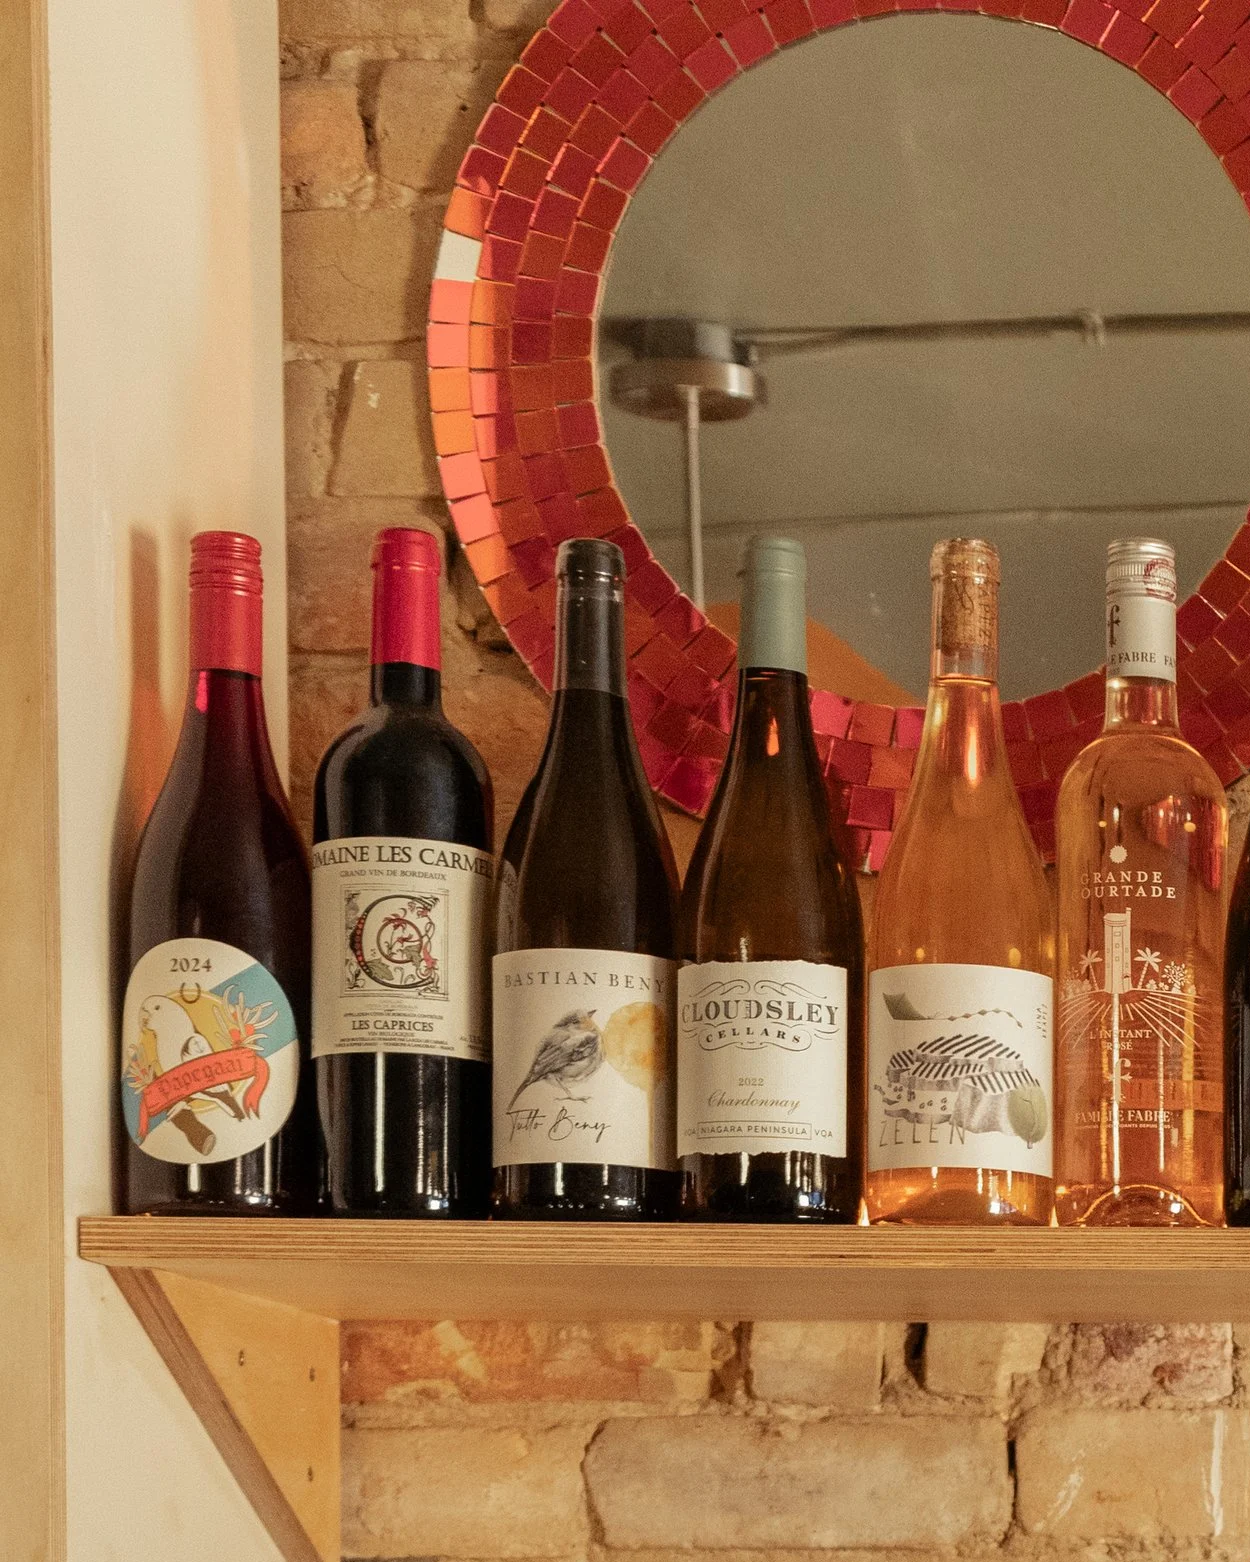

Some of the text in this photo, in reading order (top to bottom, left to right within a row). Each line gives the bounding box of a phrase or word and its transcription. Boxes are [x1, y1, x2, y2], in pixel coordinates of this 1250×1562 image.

[1118, 652, 1157, 664] FABRE
[313, 846, 369, 869] MAINE
[376, 845, 412, 863] LES
[400, 870, 448, 881] BORDEAUX
[1081, 871, 1163, 885] GRANDE
[170, 958, 212, 972] 2024
[504, 971, 665, 993] BASTIAN BENY
[682, 1000, 839, 1026] CLOUDSLEY
[352, 1020, 434, 1032] LES CAPRICES
[706, 1027, 801, 1045] CELLARS
[738, 1077, 764, 1087] 2022
[707, 1089, 801, 1115] Chardonnay
[548, 1106, 612, 1144] Beny
[701, 1124, 743, 1135] NIAGARA
[747, 1124, 807, 1136] PENINSULA
[814, 1129, 833, 1138] VQA
[879, 1115, 966, 1147] ZELEN
